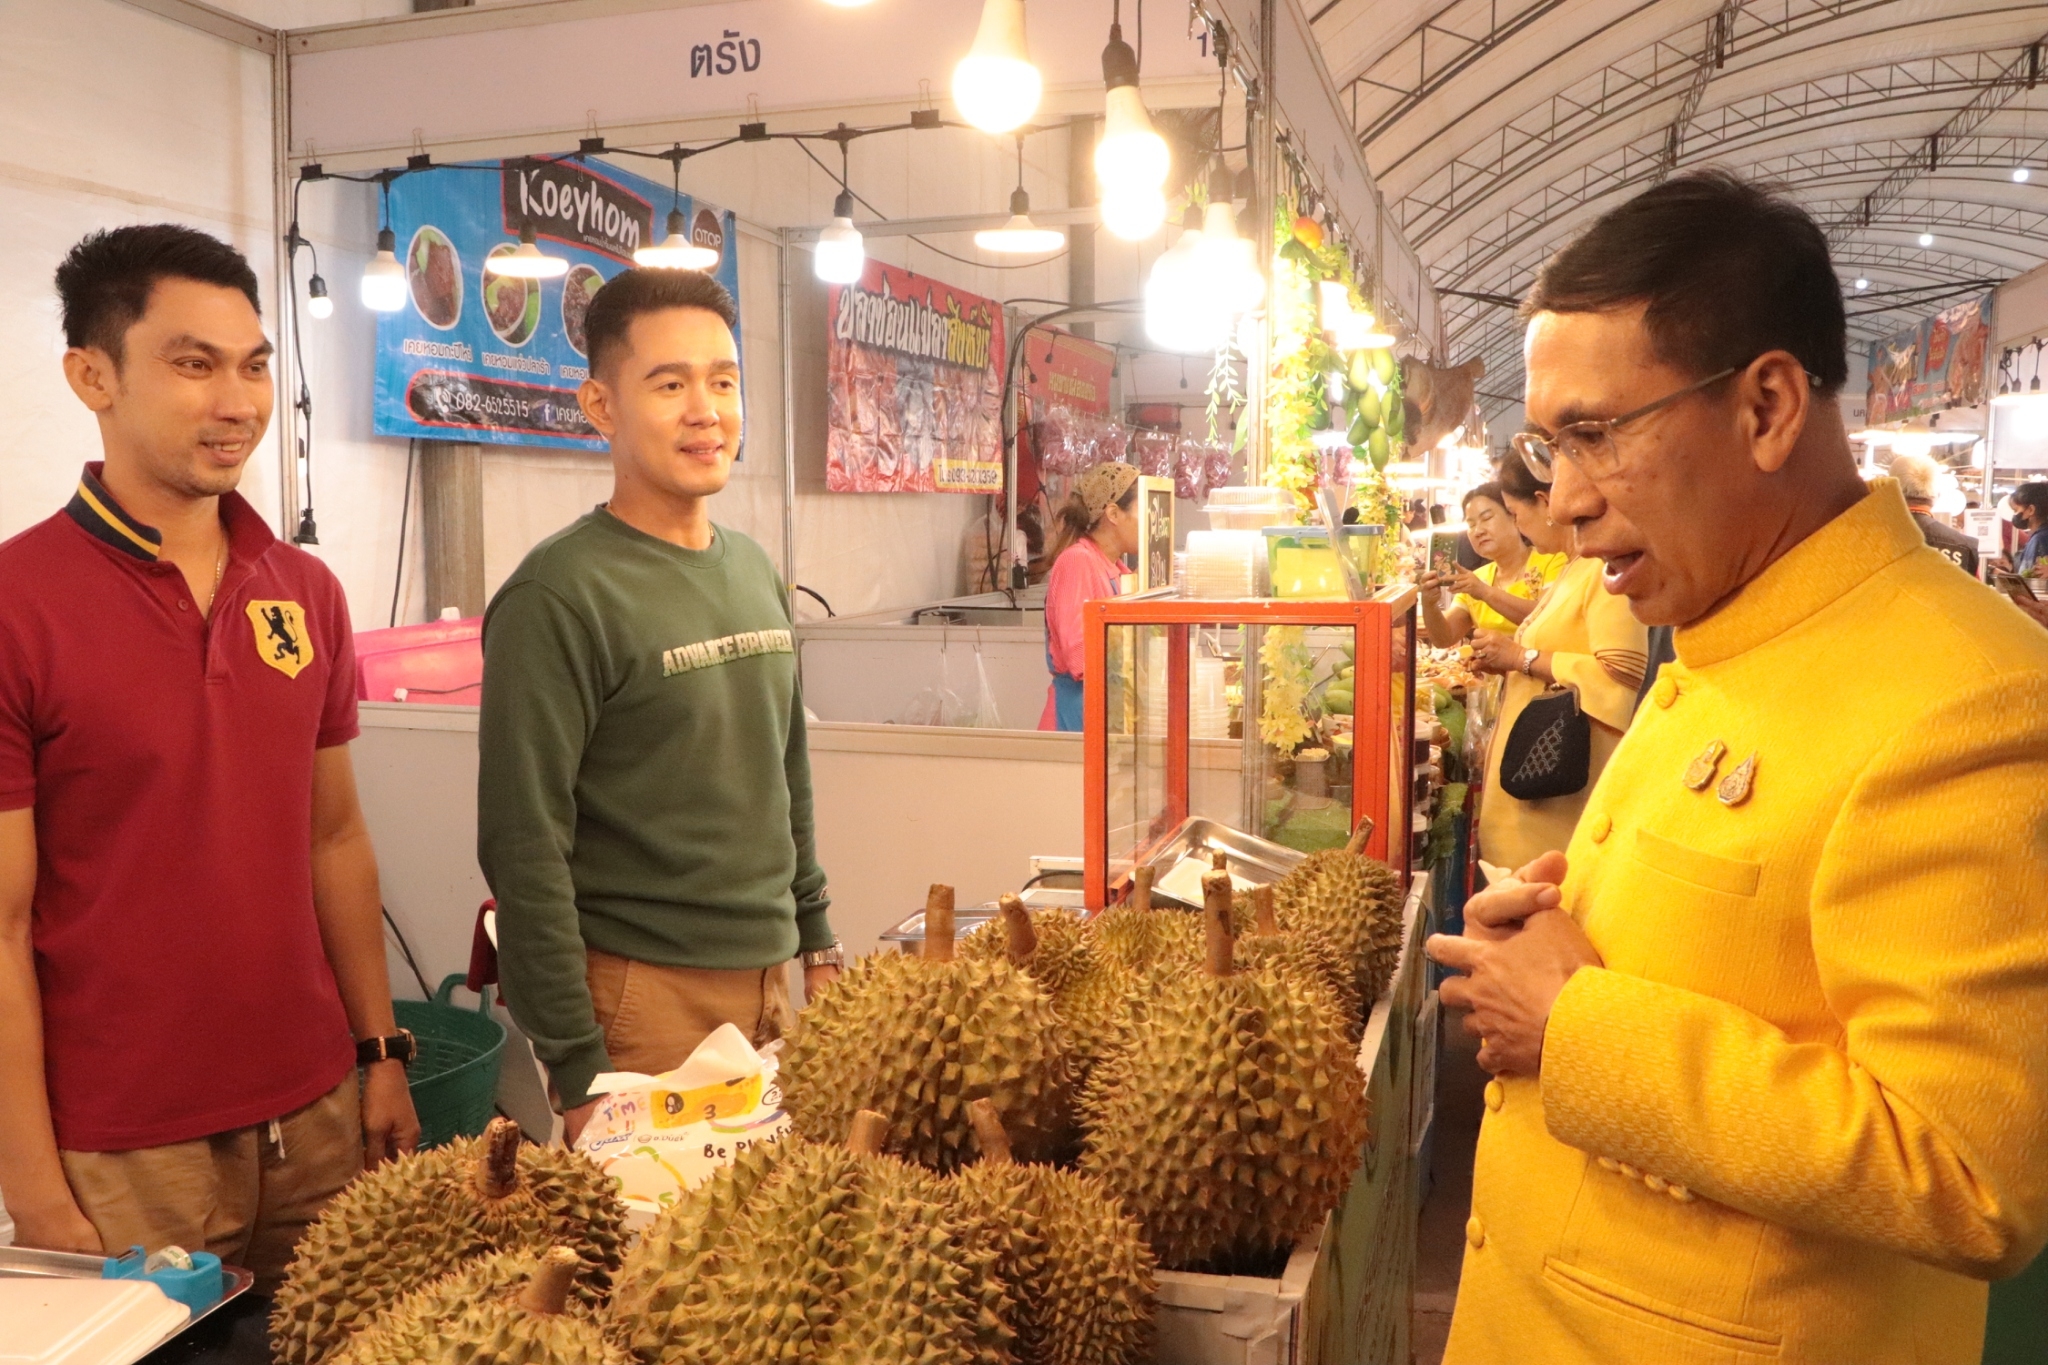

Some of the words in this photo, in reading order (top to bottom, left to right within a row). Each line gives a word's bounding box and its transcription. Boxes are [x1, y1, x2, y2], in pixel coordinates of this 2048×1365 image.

[690, 29, 761, 78] ตรัง
[519, 168, 640, 251] Koeyhom
[694, 227, 722, 248] OTOP
[456, 391, 529, 418] 082-6525515
[703, 1143, 727, 1159] Be
